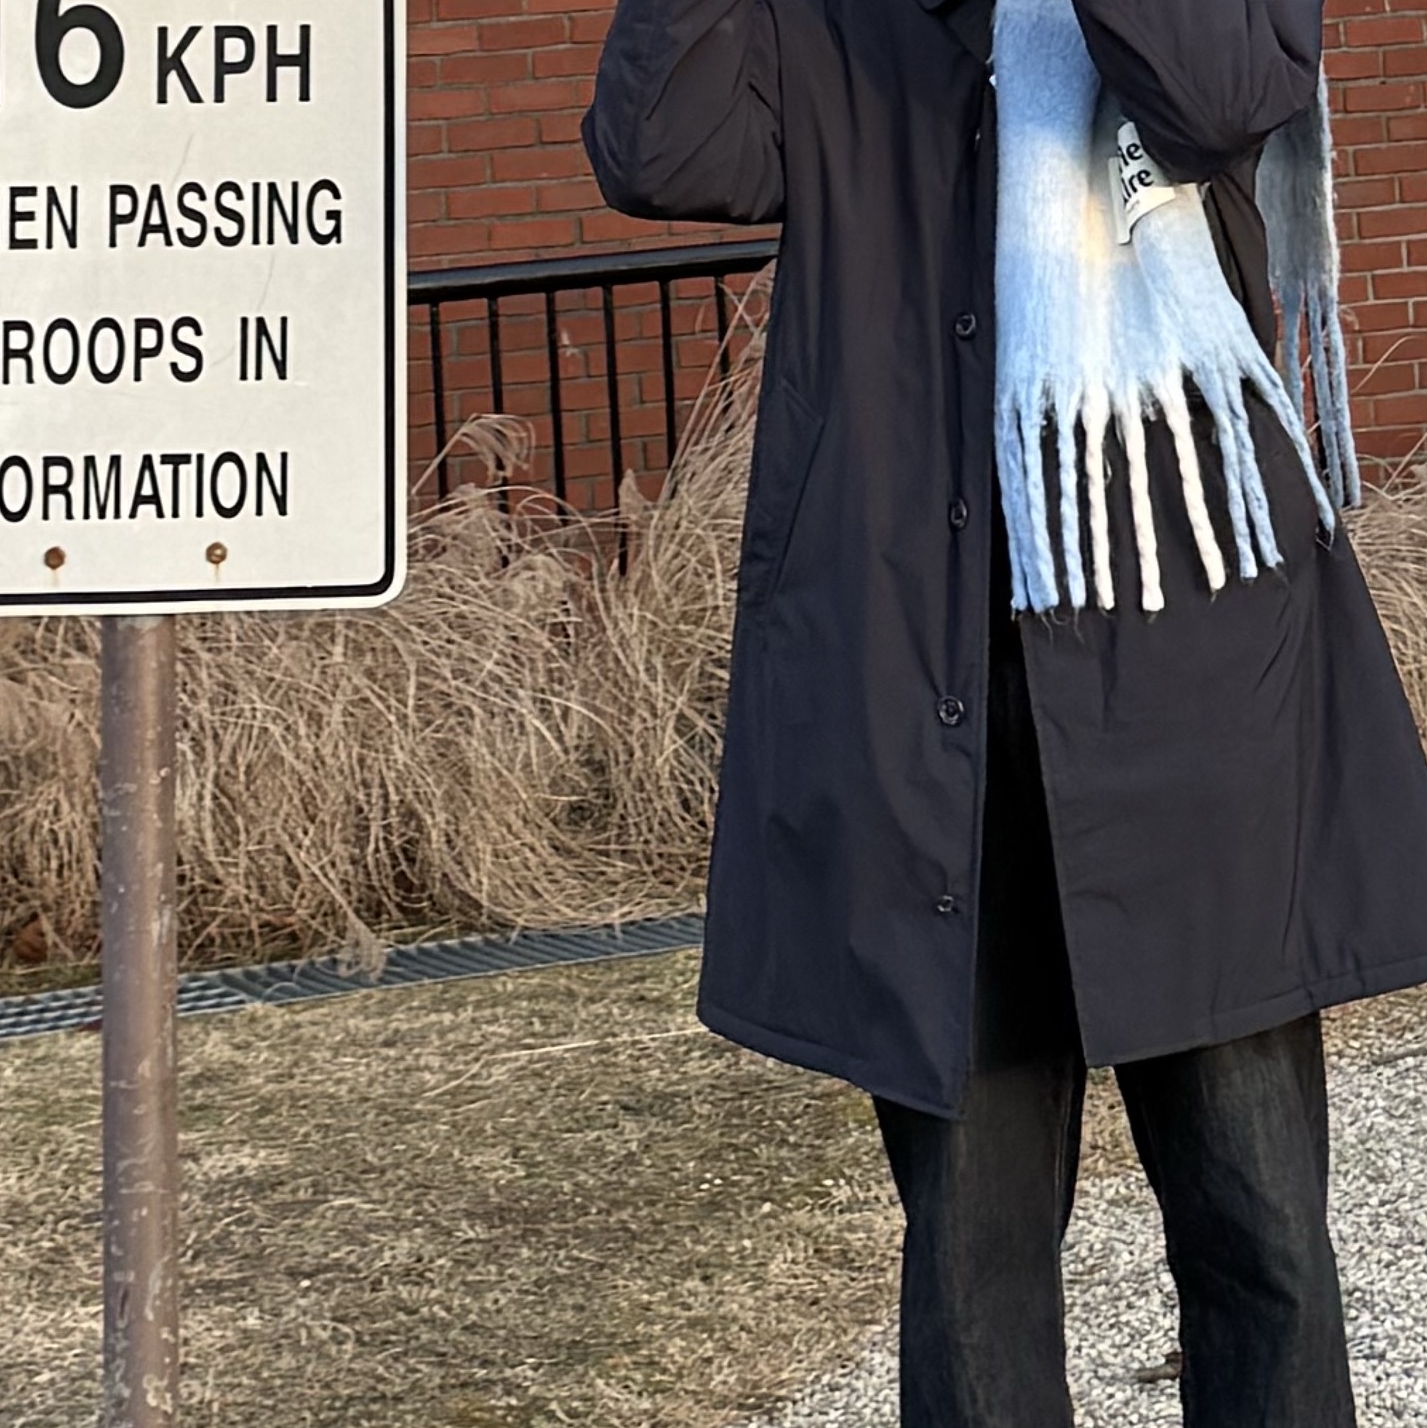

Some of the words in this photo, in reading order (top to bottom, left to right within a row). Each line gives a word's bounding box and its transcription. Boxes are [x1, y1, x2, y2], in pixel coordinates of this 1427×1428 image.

[157, 24, 310, 104] KPH
[109, 179, 341, 247] PASSING
[240, 316, 287, 381] IN
